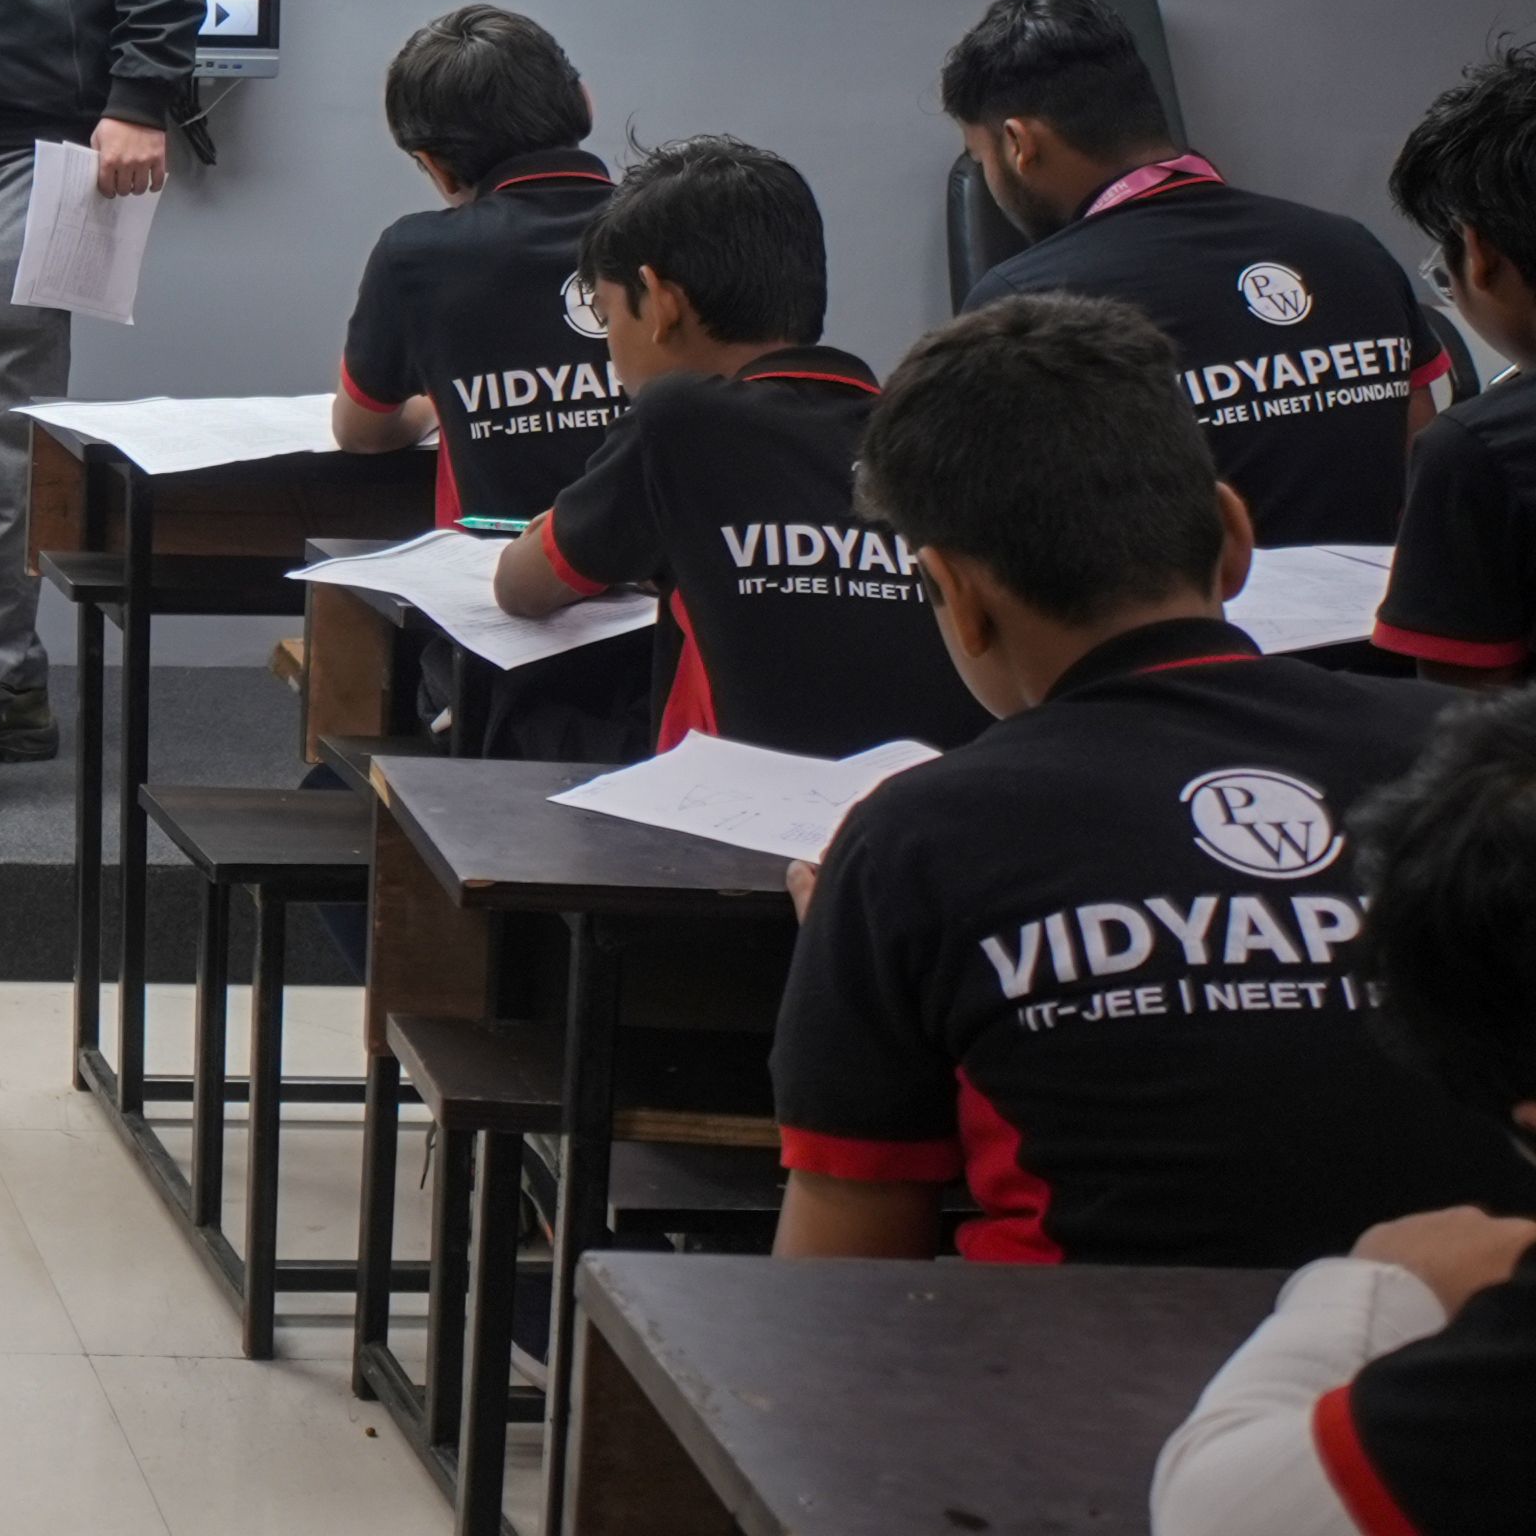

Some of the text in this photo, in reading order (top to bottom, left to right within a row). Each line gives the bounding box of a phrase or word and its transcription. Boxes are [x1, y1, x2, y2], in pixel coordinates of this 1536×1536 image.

[1175, 337, 1412, 405] IDYAPEETH
[1265, 395, 1312, 418] NEET
[470, 414, 542, 440] IIT-JEE
[558, 408, 609, 430] NEET
[738, 577, 910, 601] IIT-JEE NEET
[980, 893, 1372, 1001] VIDYAP
[1206, 982, 1327, 1012] NEET
